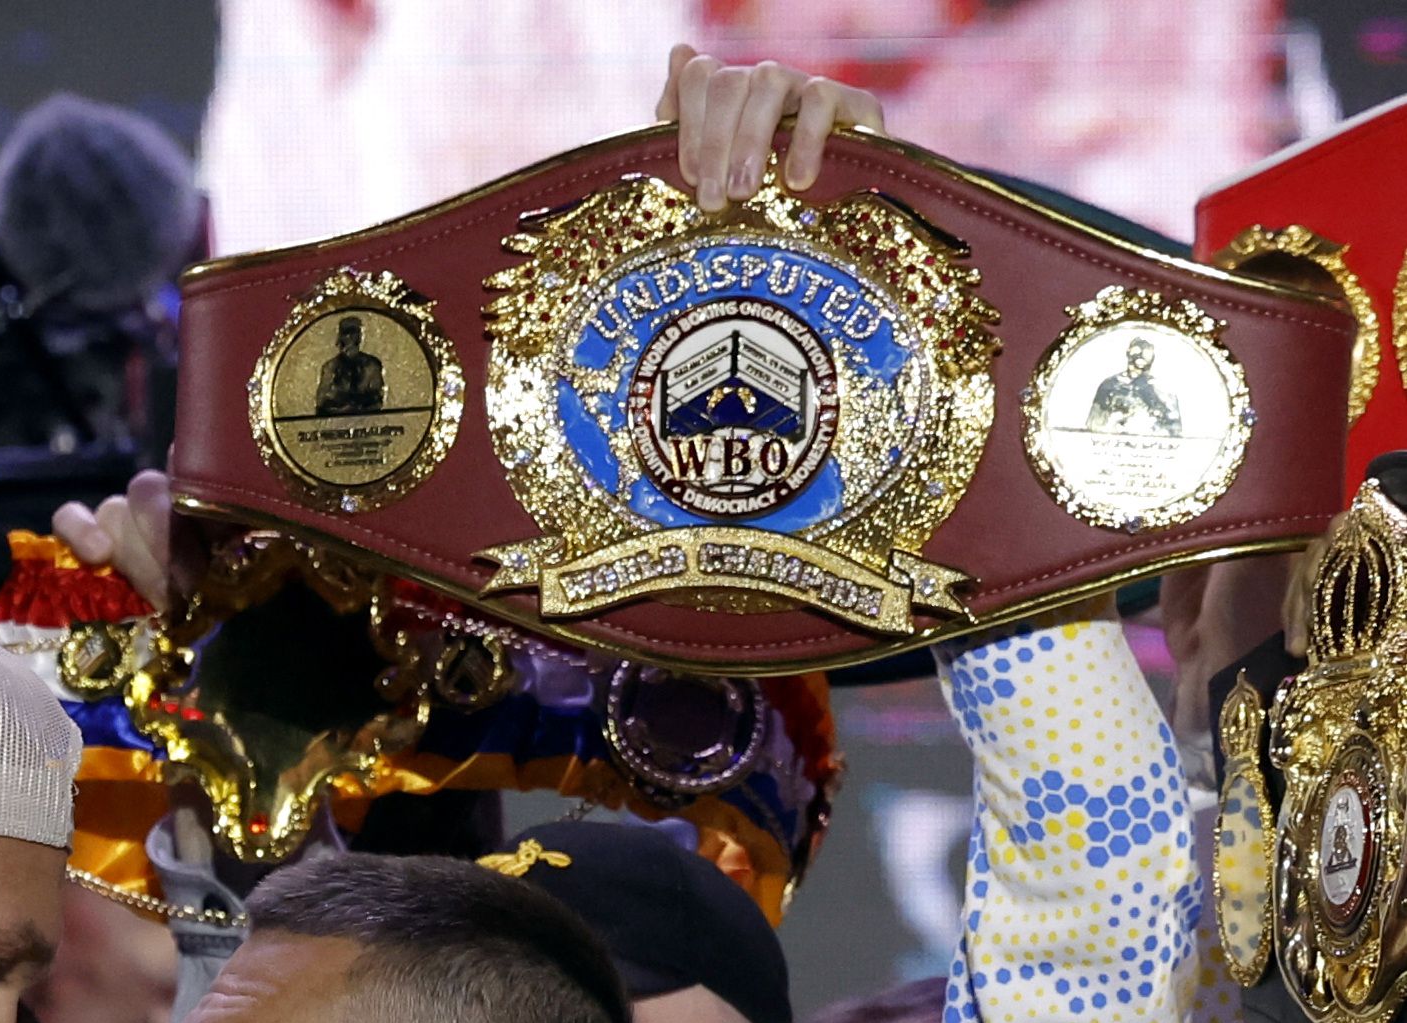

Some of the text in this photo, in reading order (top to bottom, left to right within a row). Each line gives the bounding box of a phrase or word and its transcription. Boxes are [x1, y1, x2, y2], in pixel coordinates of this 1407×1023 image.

[594, 255, 886, 339] UNDISPUTED
[639, 326, 682, 377] WORLD
[677, 301, 739, 331] BOXING
[738, 301, 832, 378] ORGANIZATION
[634, 421, 835, 514] DIGNITY DEMOCRACY HONESTY
[670, 437, 788, 479] WBO
[558, 542, 883, 618] WORLD CHAMPION
